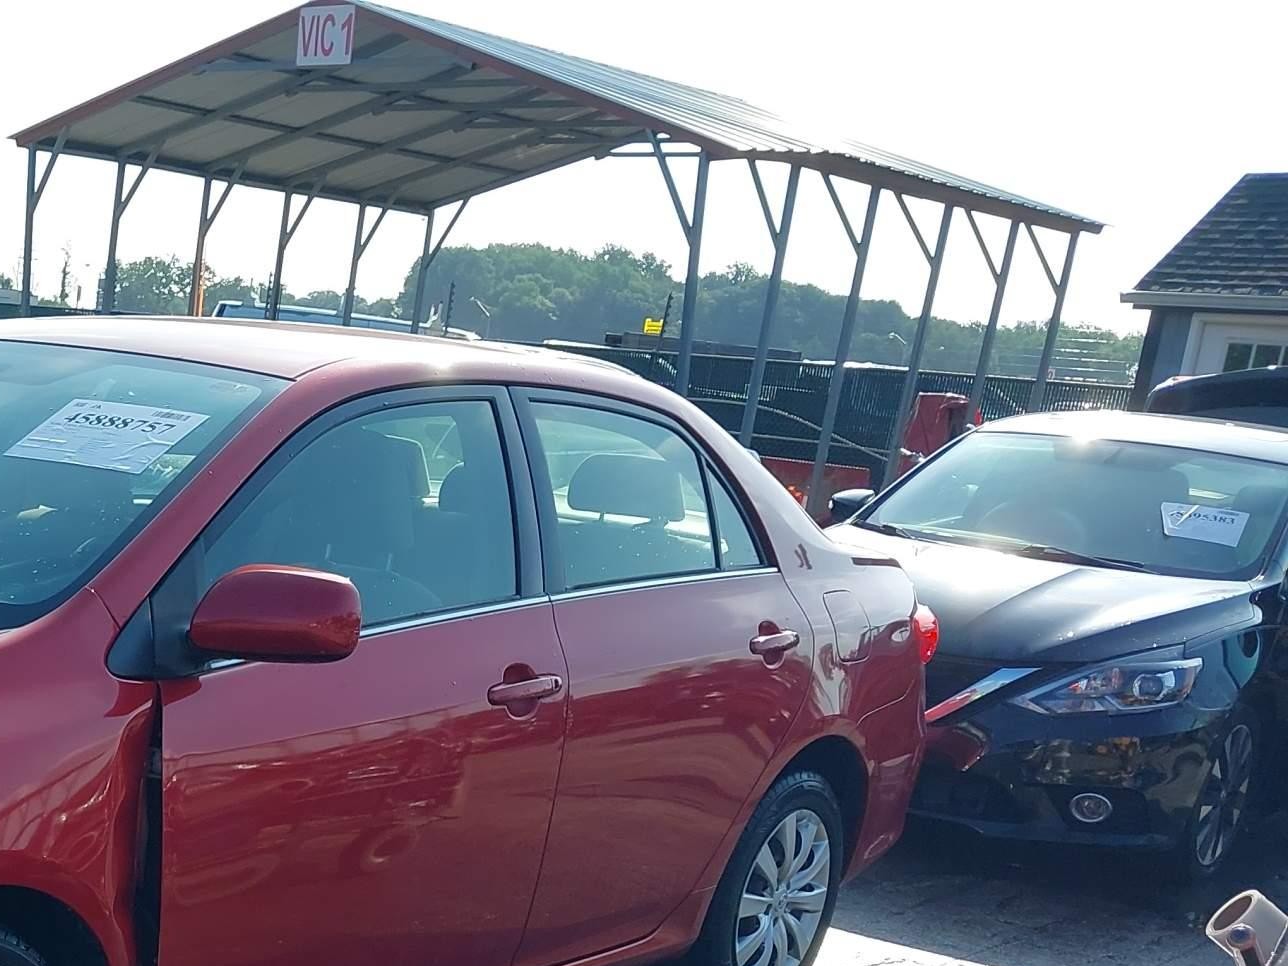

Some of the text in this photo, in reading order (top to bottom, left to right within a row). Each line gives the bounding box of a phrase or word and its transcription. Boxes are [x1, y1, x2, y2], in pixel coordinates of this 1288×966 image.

[301, 12, 353, 57] VIC 1
[64, 412, 177, 435] 45888757
